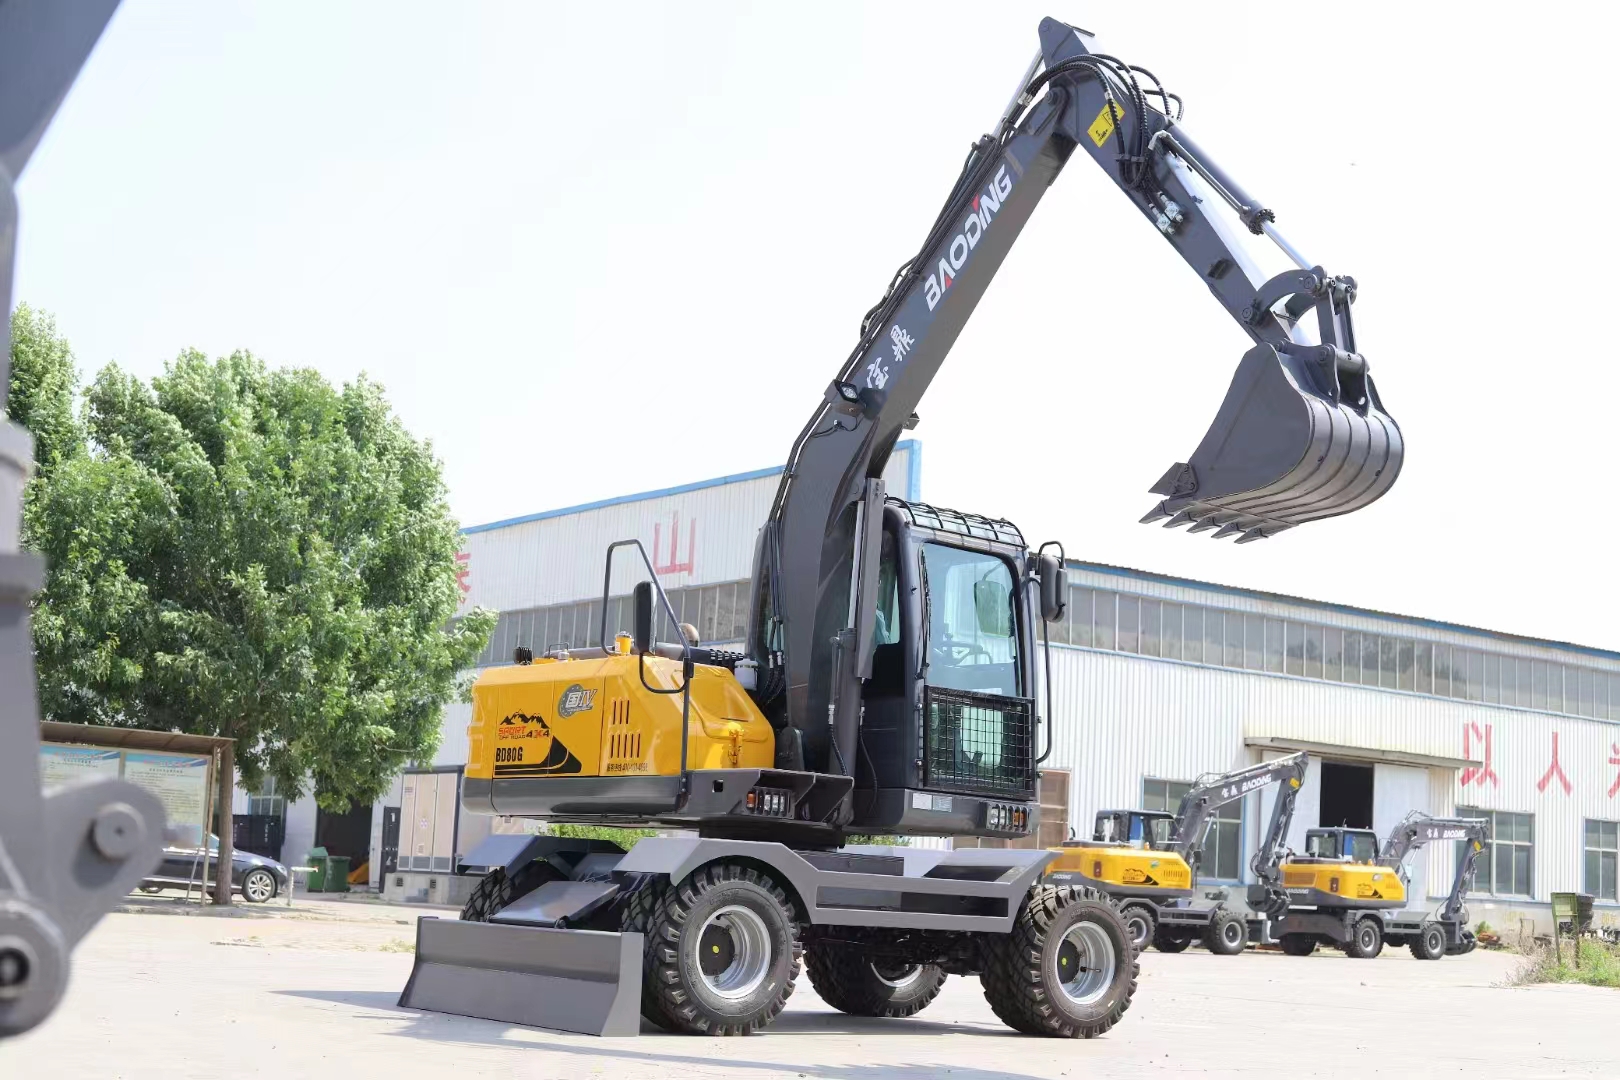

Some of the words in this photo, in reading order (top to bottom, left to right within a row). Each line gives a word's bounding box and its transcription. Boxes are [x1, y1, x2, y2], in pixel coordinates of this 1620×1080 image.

[866, 324, 915, 389] 宝鼎
[924, 164, 1013, 311] BAODING
[653, 511, 696, 577] 山
[498, 726, 526, 737] SPORT
[495, 746, 523, 762] BD80G
[1242, 773, 1272, 792] BAODING
